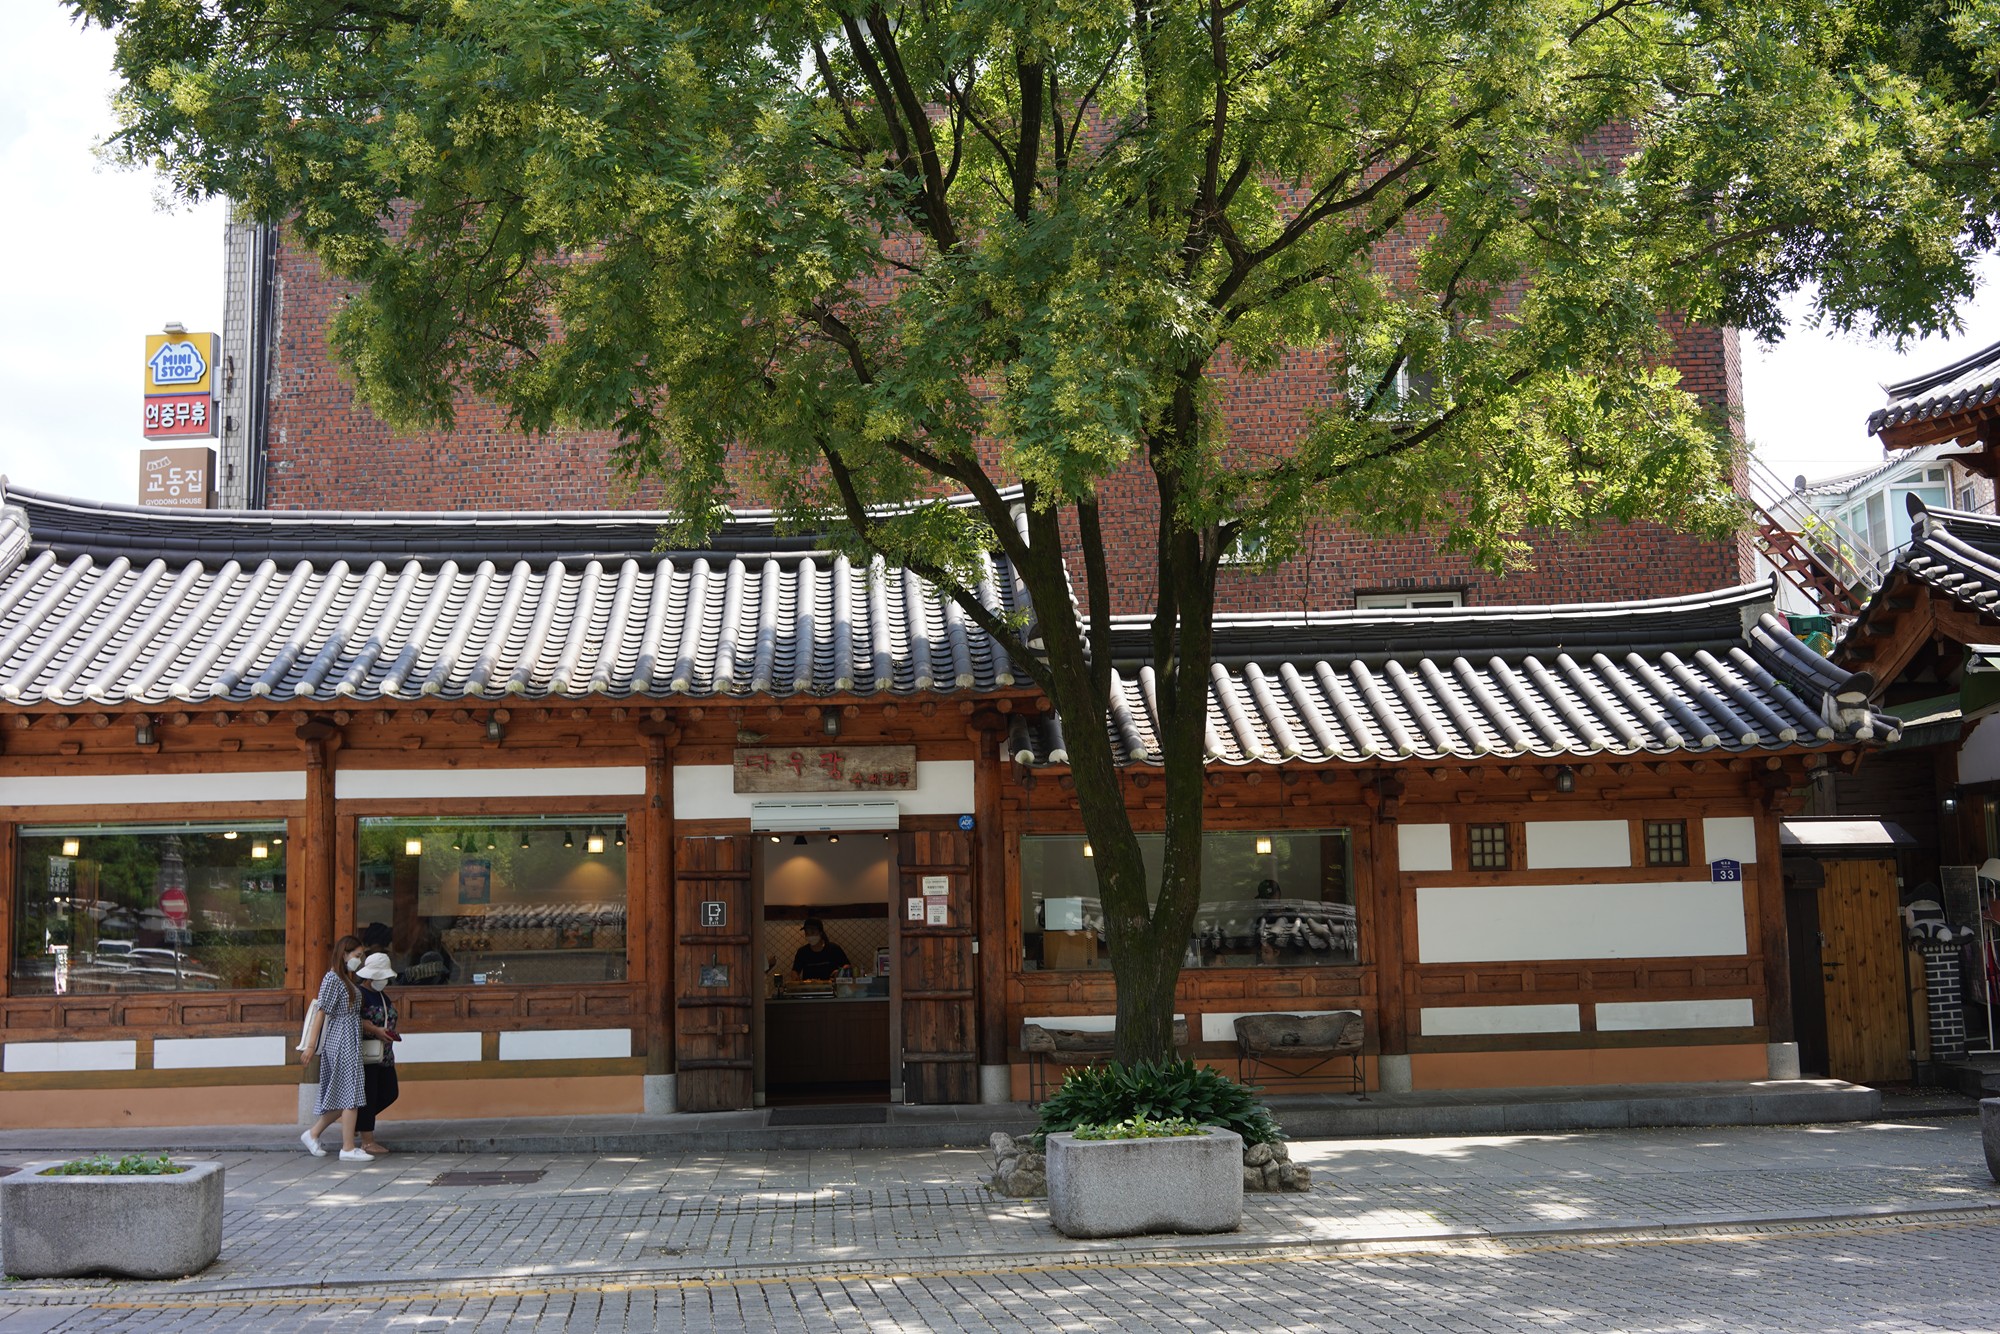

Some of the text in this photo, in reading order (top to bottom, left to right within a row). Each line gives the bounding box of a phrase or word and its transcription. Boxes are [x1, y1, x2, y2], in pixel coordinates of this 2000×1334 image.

[163, 354, 191, 365] MINI
[161, 365, 193, 378] STOP
[145, 402, 206, 428] 연중무휴
[147, 468, 202, 496] 교동집
[145, 497, 202, 506] GYODONG HOUSE
[1720, 870, 1734, 880] 33
